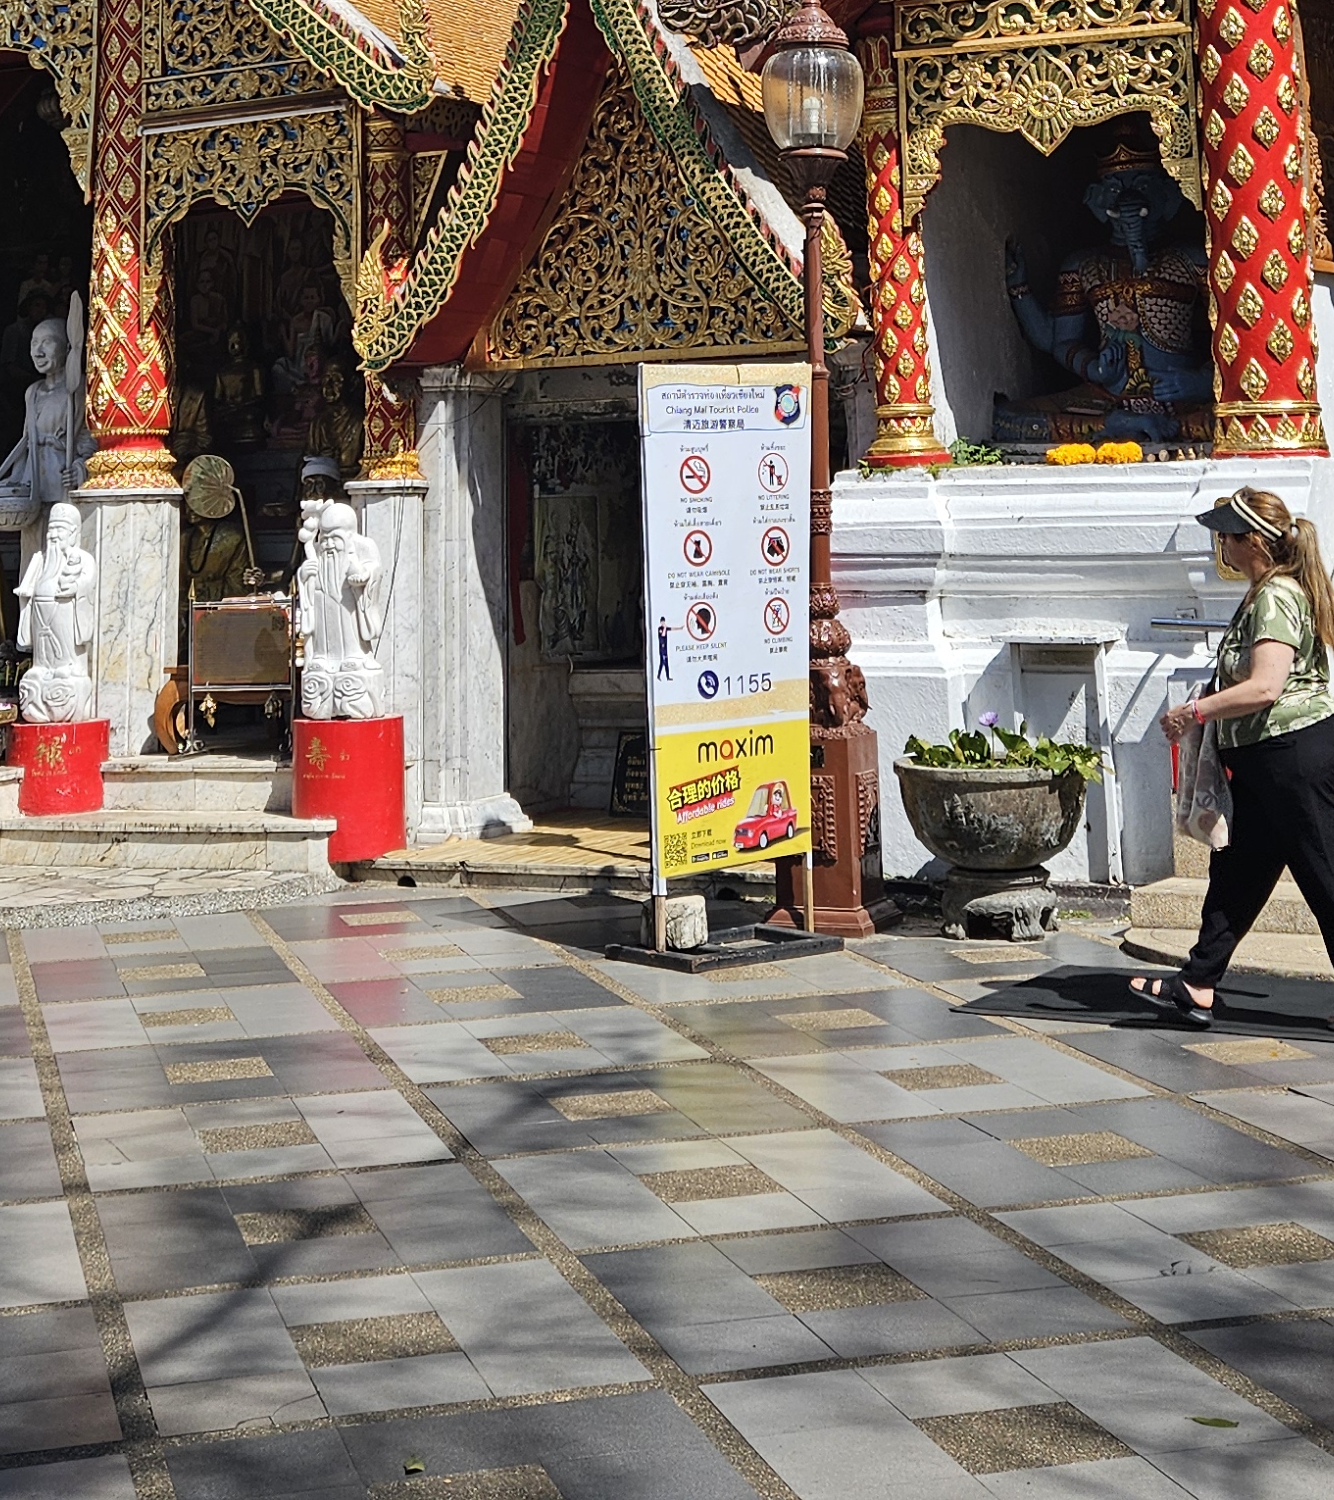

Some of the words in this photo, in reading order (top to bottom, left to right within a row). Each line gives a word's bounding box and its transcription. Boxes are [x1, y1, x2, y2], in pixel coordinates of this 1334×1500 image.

[665, 405, 692, 416] Chiang
[694, 405, 707, 414] Mai
[709, 405, 735, 414] Tourist
[737, 405, 759, 414] Police
[724, 672, 772, 695] 1155
[698, 729, 773, 763] maxim
[667, 770, 740, 811] 合理的价格
[677, 803, 715, 824] Affordable
[716, 797, 735, 810] rides
[691, 840, 714, 849] Download
